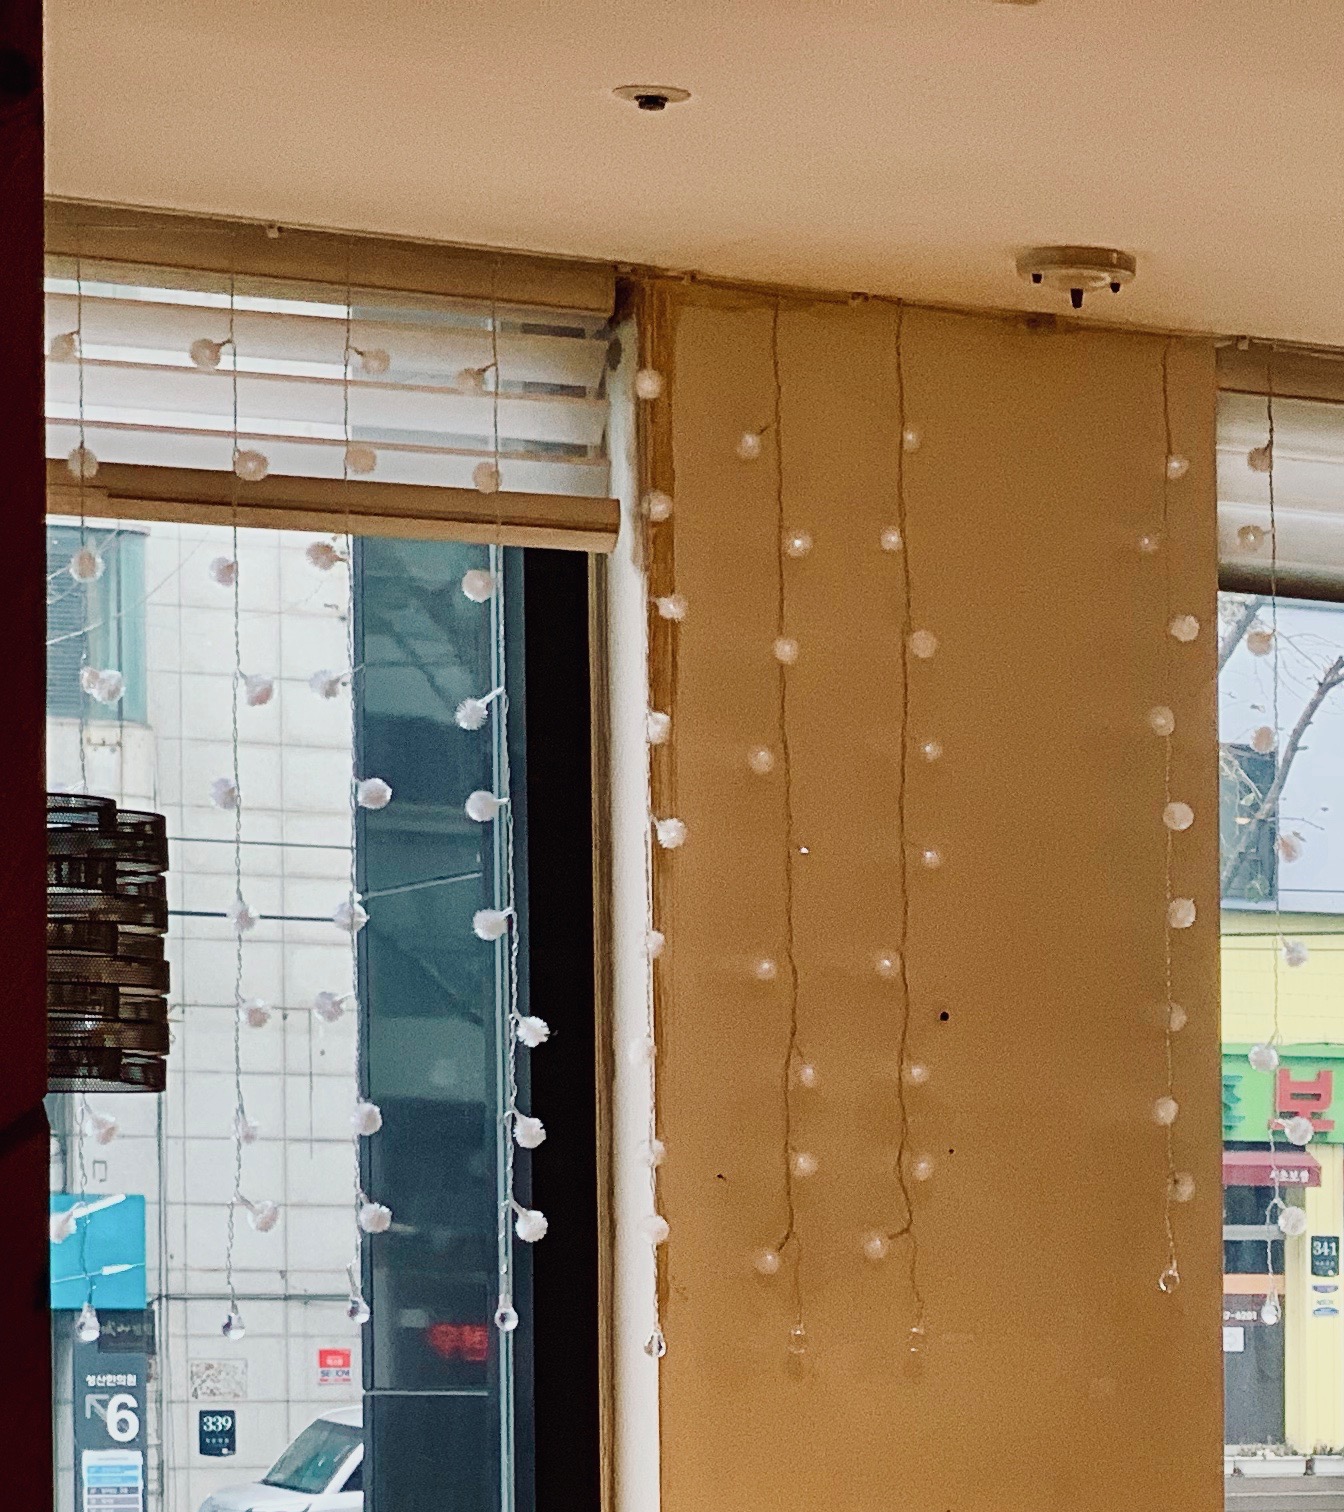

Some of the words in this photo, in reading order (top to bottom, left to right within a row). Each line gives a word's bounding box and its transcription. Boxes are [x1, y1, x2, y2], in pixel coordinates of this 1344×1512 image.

[1312, 1241, 1337, 1256] 341
[107, 1393, 140, 1443] 6
[202, 1415, 233, 1432] 339
